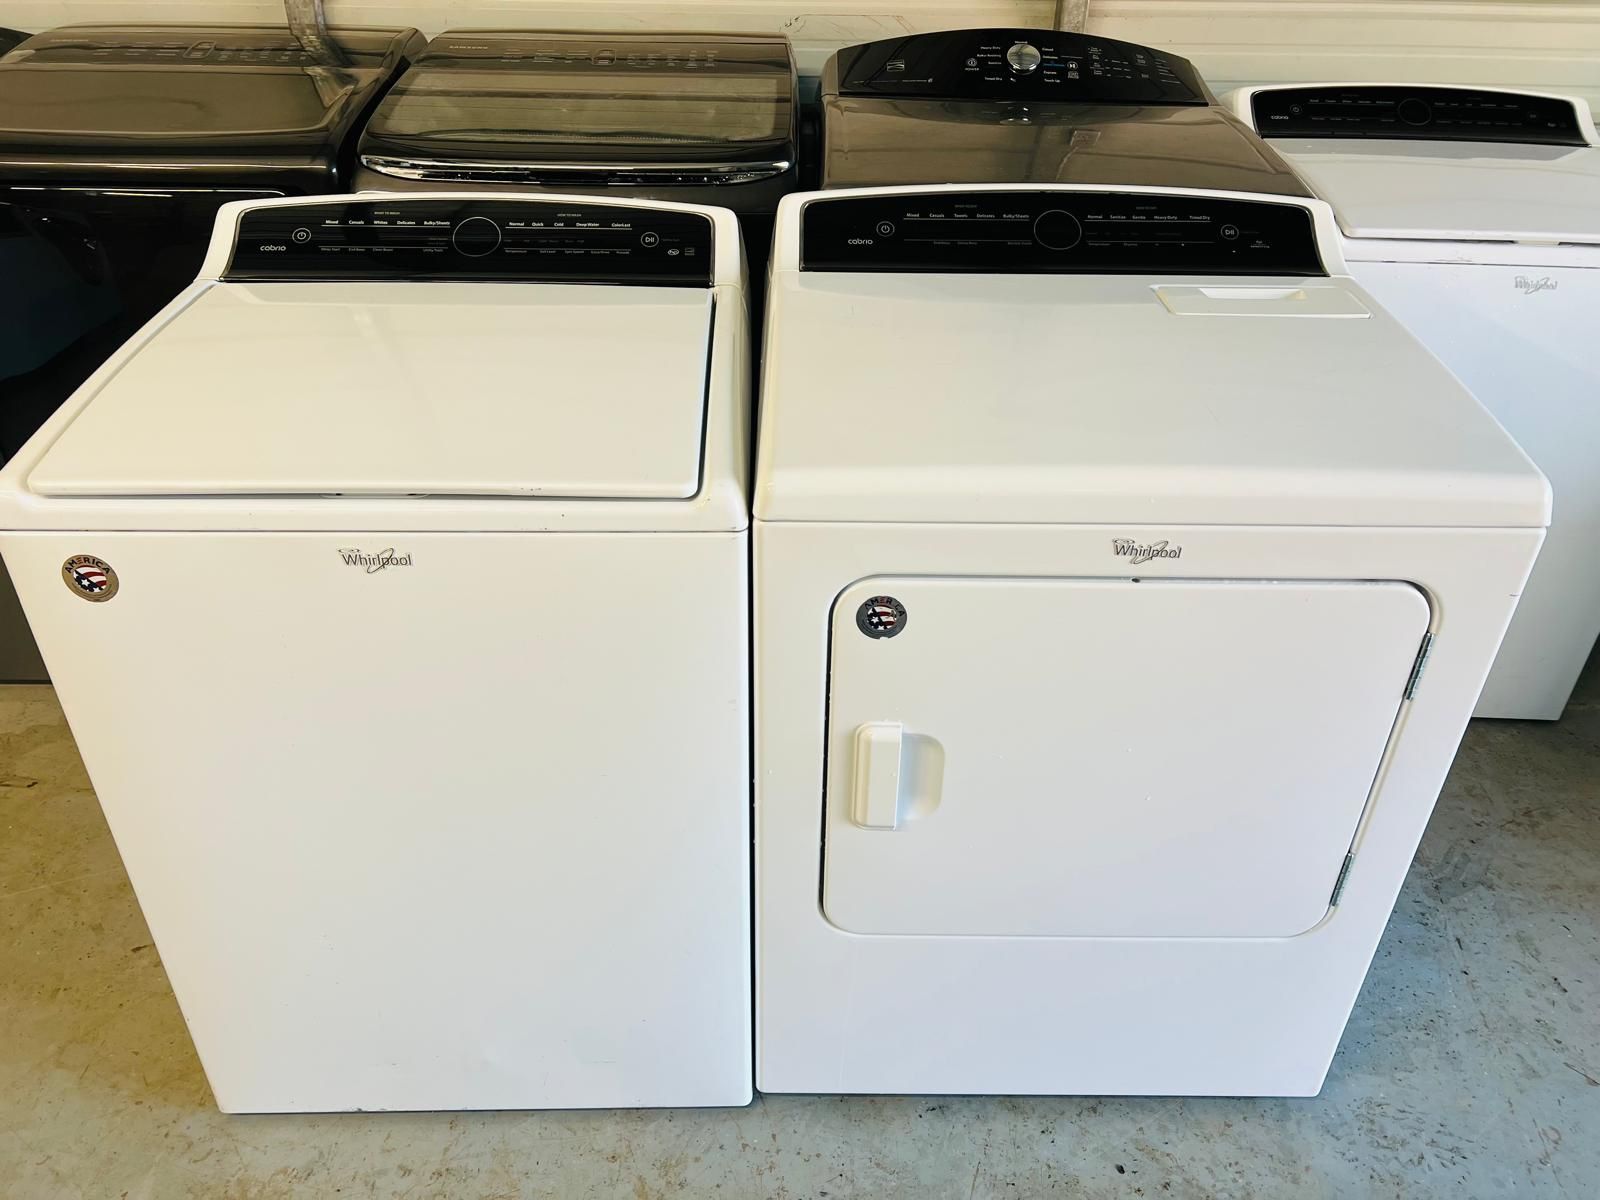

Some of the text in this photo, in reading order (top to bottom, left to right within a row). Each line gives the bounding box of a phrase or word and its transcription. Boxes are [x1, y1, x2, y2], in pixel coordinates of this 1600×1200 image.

[338, 548, 412, 573] Whirlpool
[1112, 538, 1182, 565] Whirlpool
[65, 556, 110, 574] AMERICA
